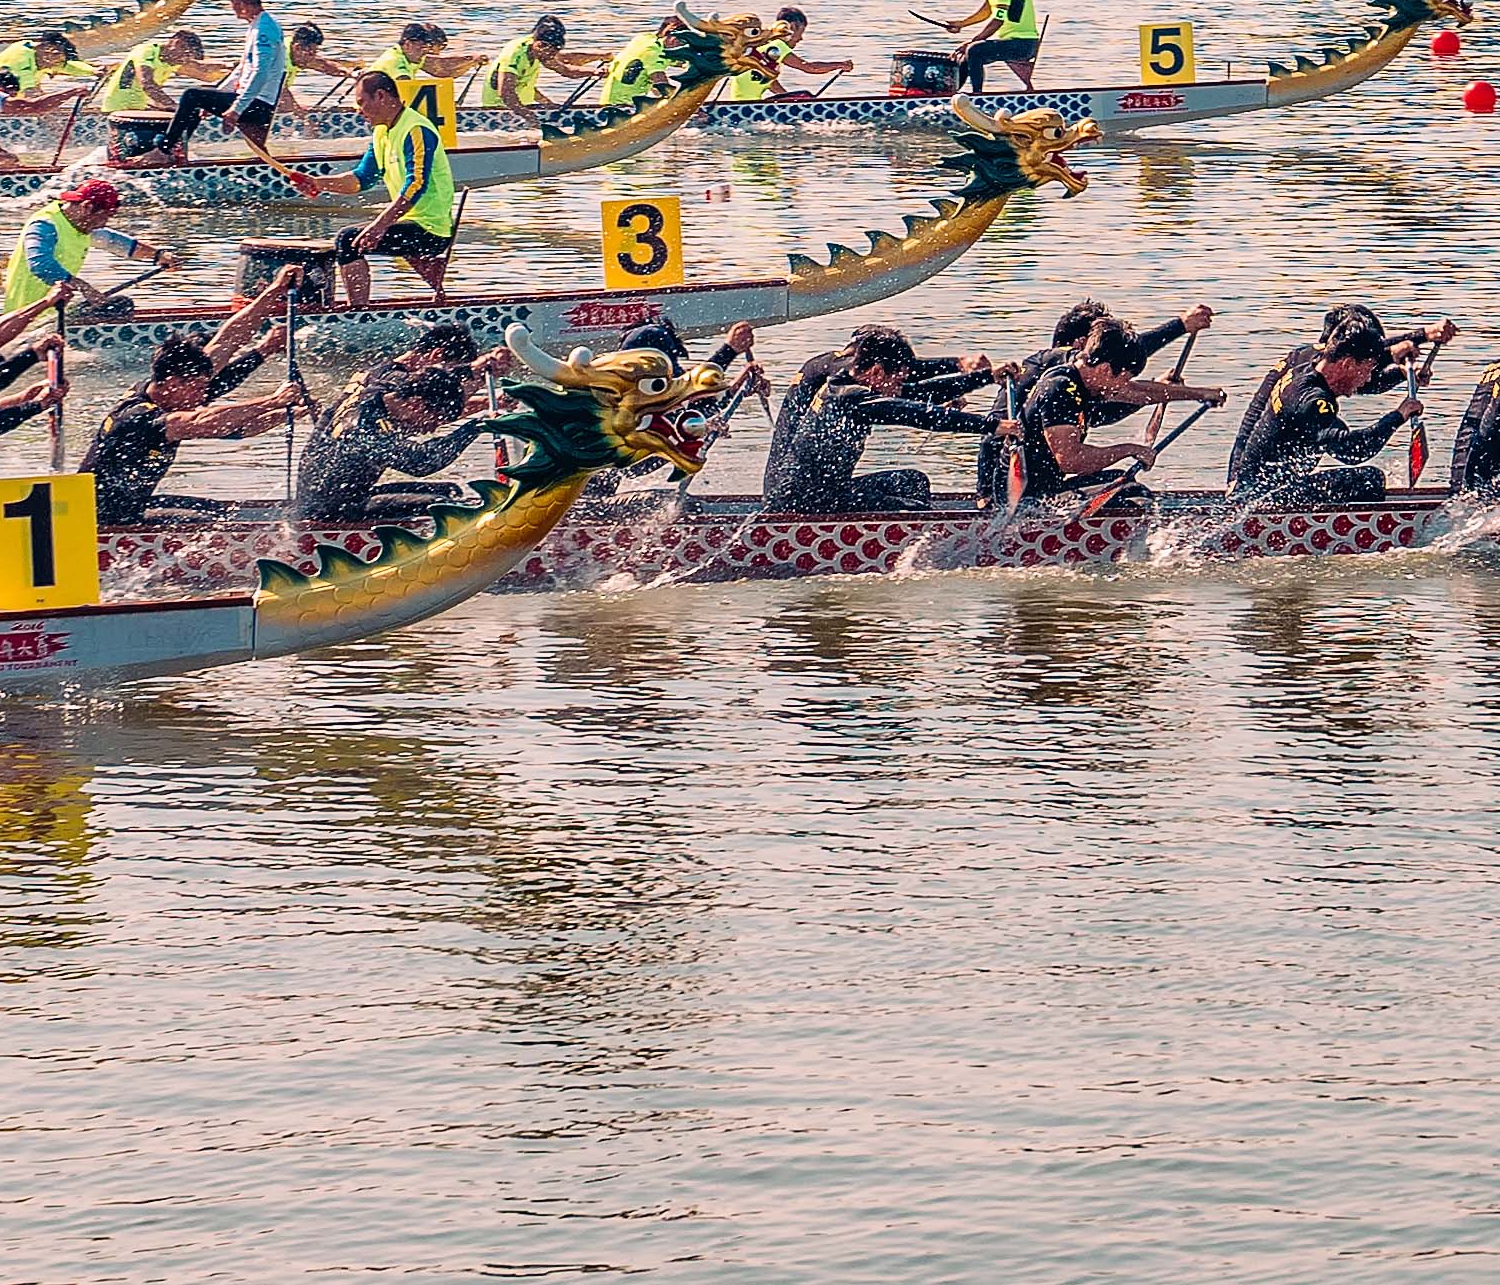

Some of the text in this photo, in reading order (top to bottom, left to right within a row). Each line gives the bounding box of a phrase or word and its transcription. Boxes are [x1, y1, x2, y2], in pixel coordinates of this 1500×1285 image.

[1149, 28, 1184, 76] 5
[410, 84, 445, 128] 4
[617, 204, 666, 276] 3
[3, 482, 56, 588] 1
[11, 621, 45, 631] 2016
